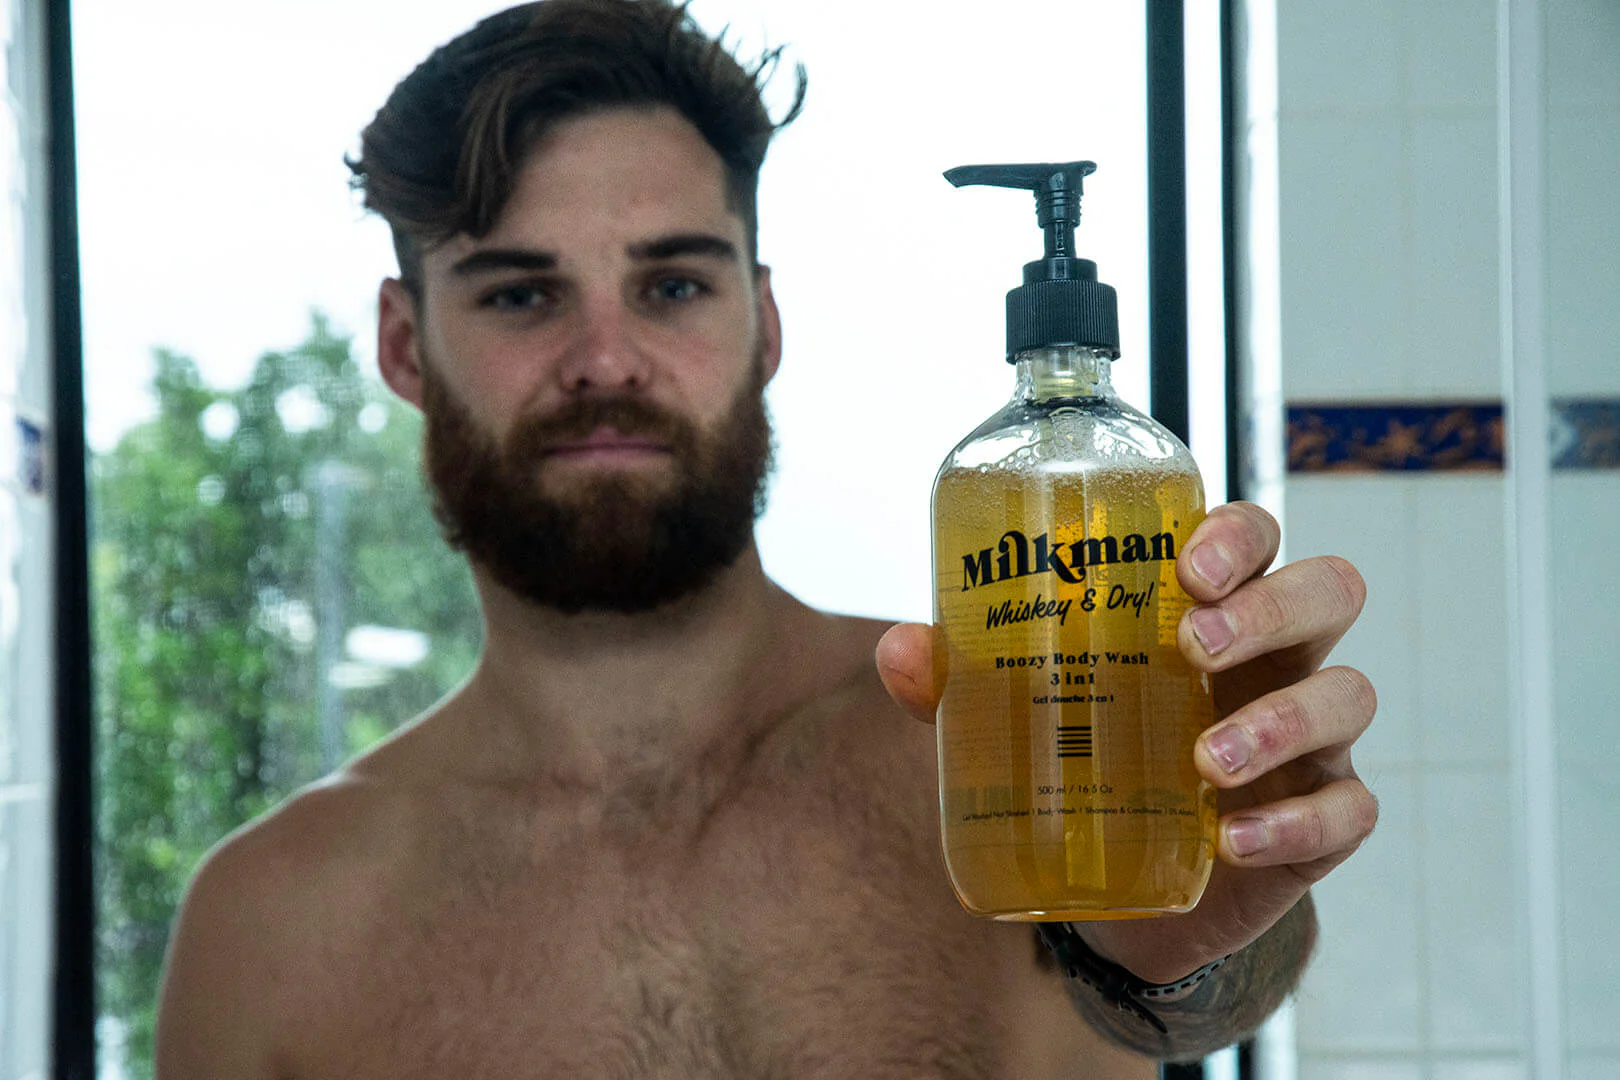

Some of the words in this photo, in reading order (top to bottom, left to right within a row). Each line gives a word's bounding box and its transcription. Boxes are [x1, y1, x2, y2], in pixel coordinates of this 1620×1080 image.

[961, 530, 1177, 592] Milkman
[986, 593, 1072, 630] Whiskey
[1081, 587, 1096, 612] &
[1107, 581, 1155, 618] Dry!
[995, 655, 1047, 669] Boozy
[1053, 651, 1100, 667] Body
[1105, 651, 1149, 665] Wash
[1050, 672, 1060, 686] 3
[1032, 696, 1048, 704] Gel
[1050, 694, 1086, 704] douche
[1037, 784, 1054, 795] 500
[1056, 783, 1066, 794] ml
[1099, 783, 1113, 794] Oz
